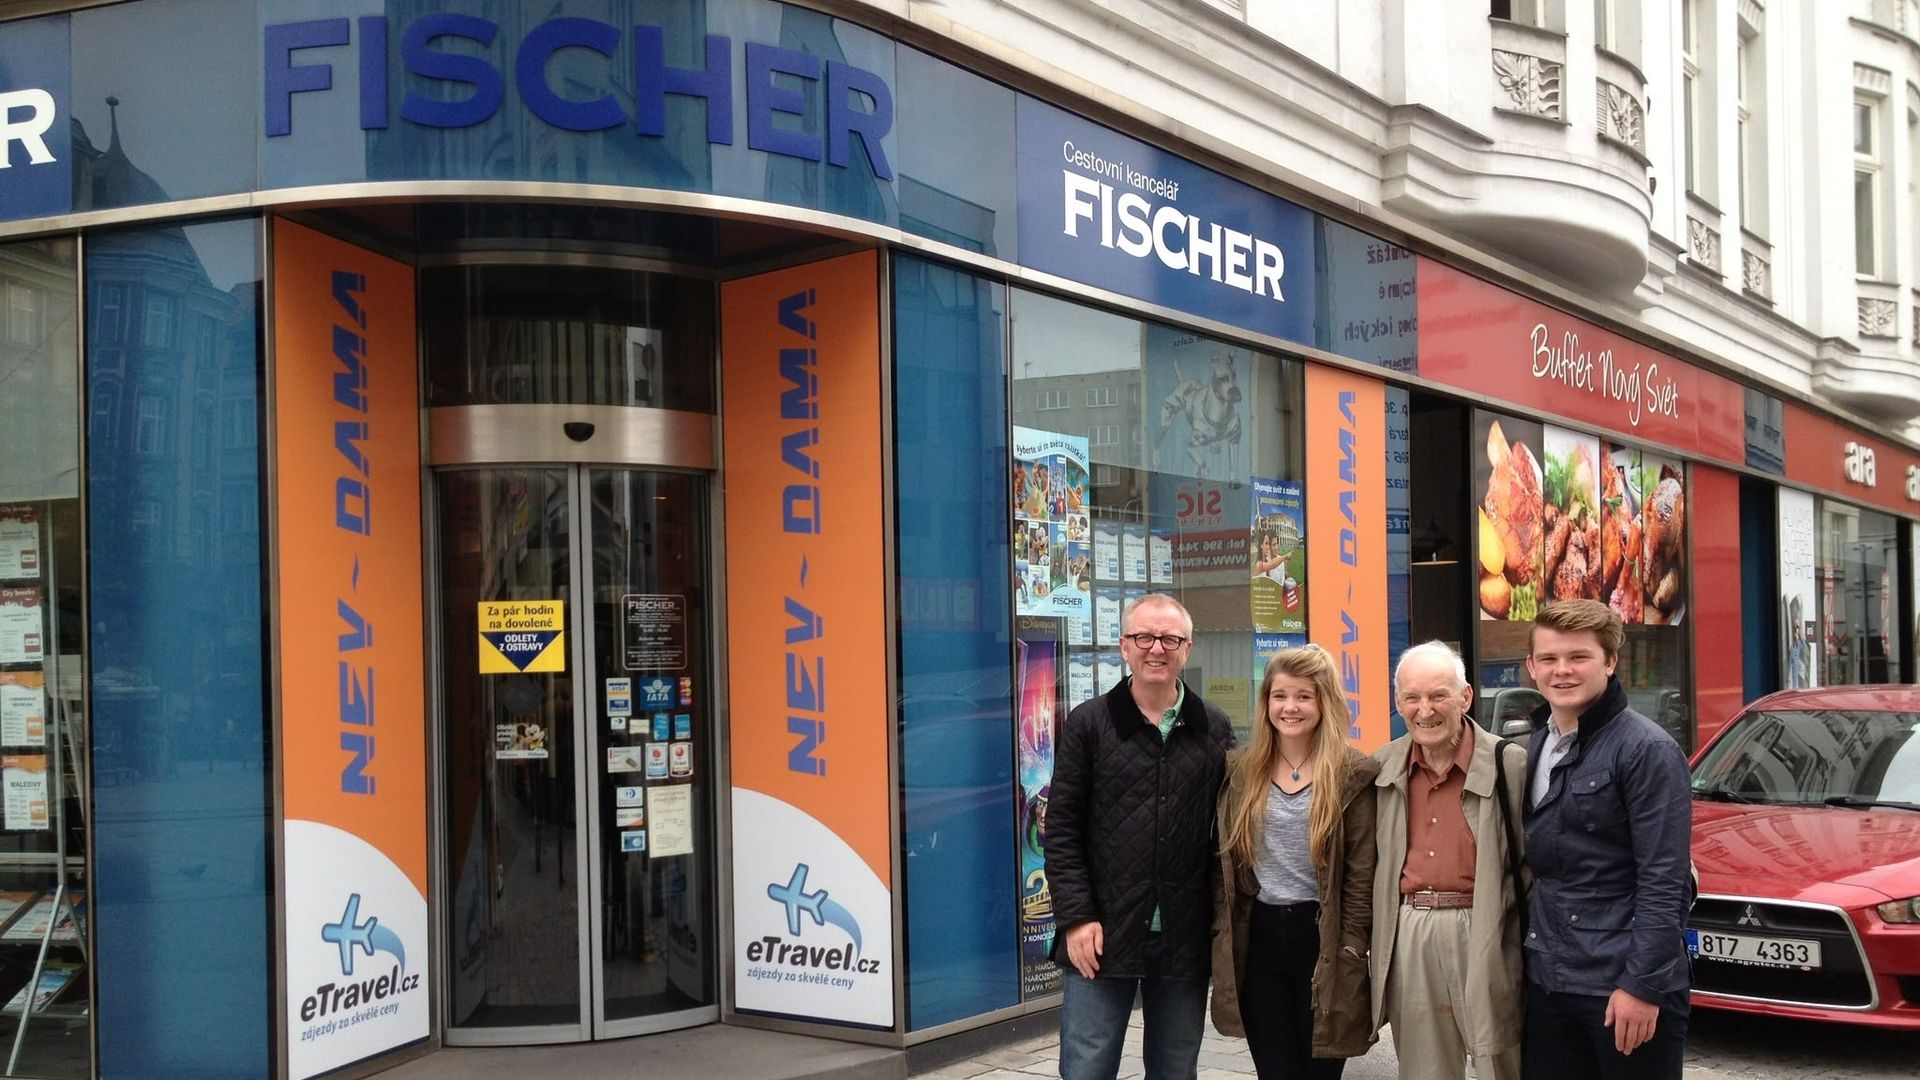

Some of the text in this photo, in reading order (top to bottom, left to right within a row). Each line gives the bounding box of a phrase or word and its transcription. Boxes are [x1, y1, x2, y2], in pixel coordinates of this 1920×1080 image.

[265, 13, 893, 181] FISCHER
[1063, 140, 1179, 201] Cestovní kancelář
[1063, 169, 1285, 302] FISCHER
[1531, 323, 1678, 426] Buffet Nový Svět
[331, 270, 371, 537] DAMA
[778, 288, 821, 535] DAMA
[1339, 391, 1357, 567] DAMA
[1844, 441, 1876, 487] ara
[487, 604, 554, 618] Za pár hodin
[489, 617, 553, 629] na dovolené
[628, 601, 675, 610] FISCHER
[1052, 597, 1083, 606] FISCHER
[504, 634, 538, 643] ODLETY
[506, 643, 544, 652] OSTRAVY
[338, 597, 376, 796] NEV
[784, 595, 826, 777] NEV
[1341, 610, 1360, 740] NEV
[646, 693, 669, 702] IATA
[747, 935, 880, 974] eTravel.cz
[1702, 935, 1809, 963] 8T7 4363
[1708, 956, 1791, 969] www.agrotec.cz
[301, 964, 419, 1022] eTravel.cz
[747, 967, 855, 990] zájezdy za skvělé ceny
[301, 1001, 400, 1042] zájezdy za skvělé ceny
